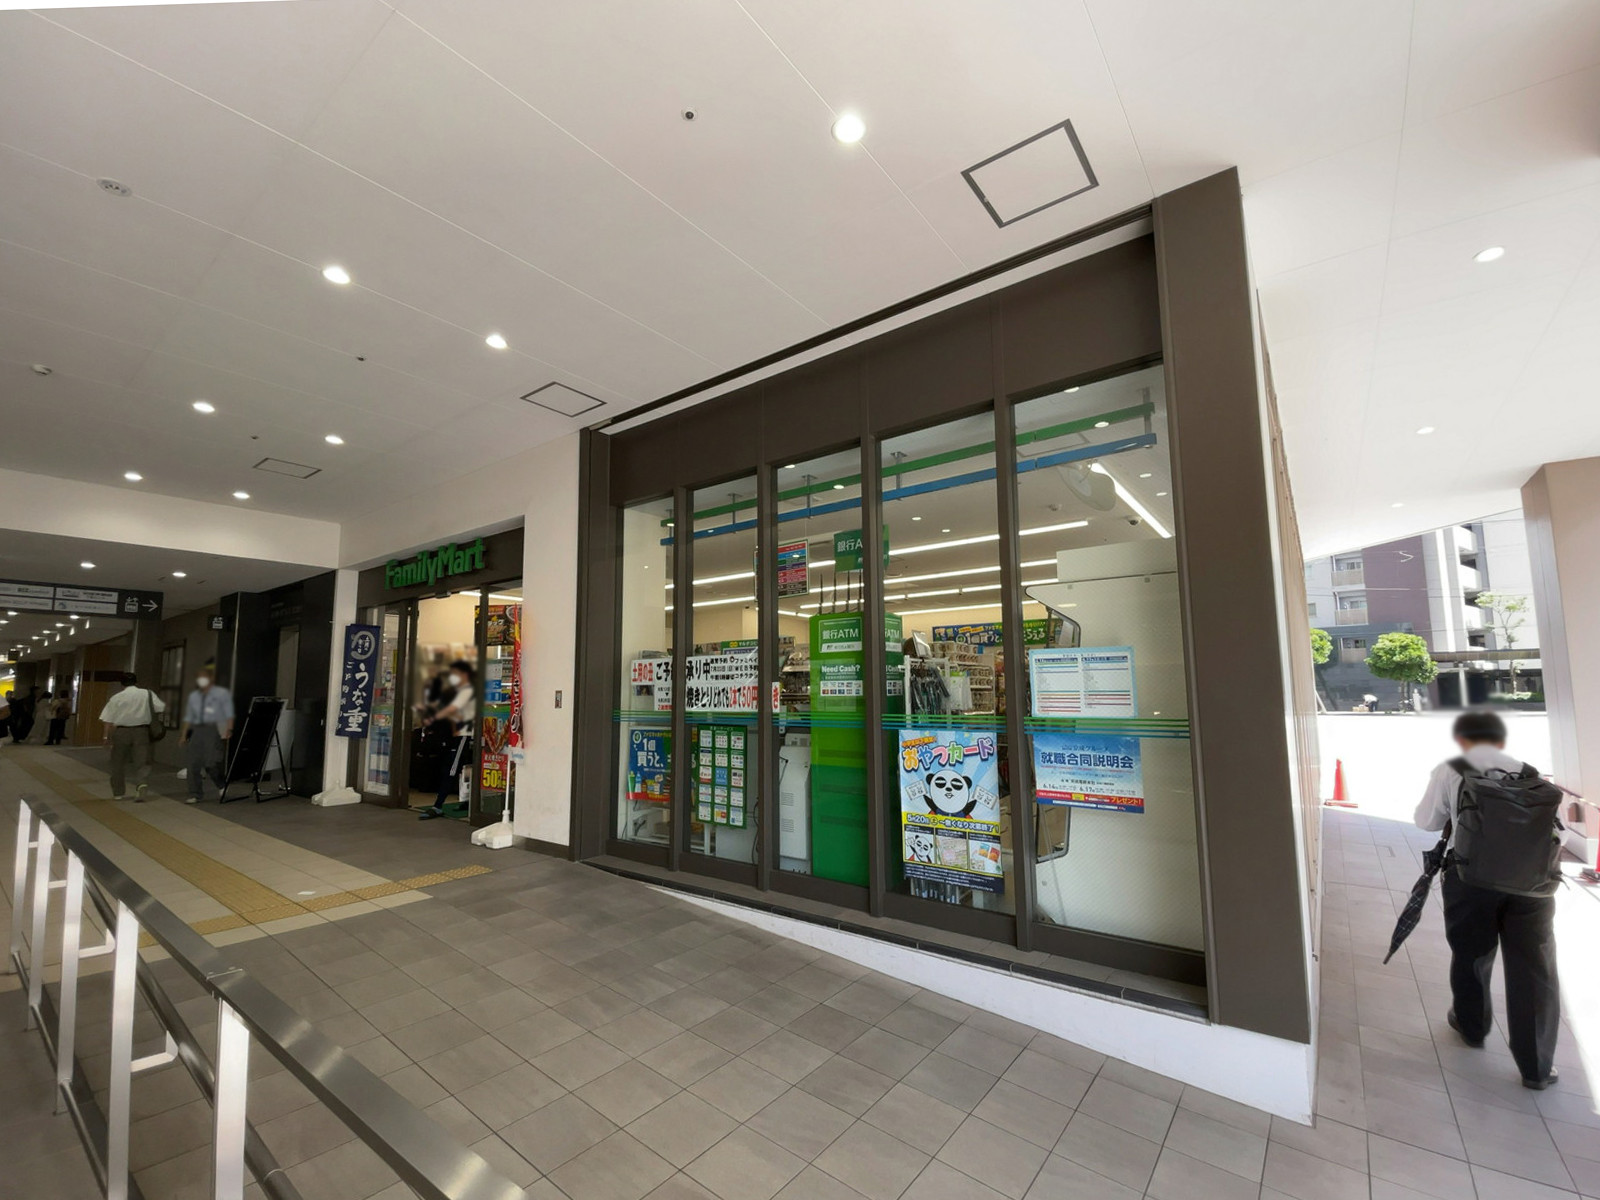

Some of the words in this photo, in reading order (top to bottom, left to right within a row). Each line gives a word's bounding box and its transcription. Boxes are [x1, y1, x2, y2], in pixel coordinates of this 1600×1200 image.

[385, 537, 485, 590] FamilyMart
[822, 628, 859, 640] 銀行ATM
[655, 661, 673, 682] ご予
[822, 665, 839, 673] Need
[840, 664, 861, 672] Cash?
[343, 662, 369, 732] うな重
[902, 737, 994, 771] おやつカード
[1041, 752, 1134, 769] 就職合同説明会
